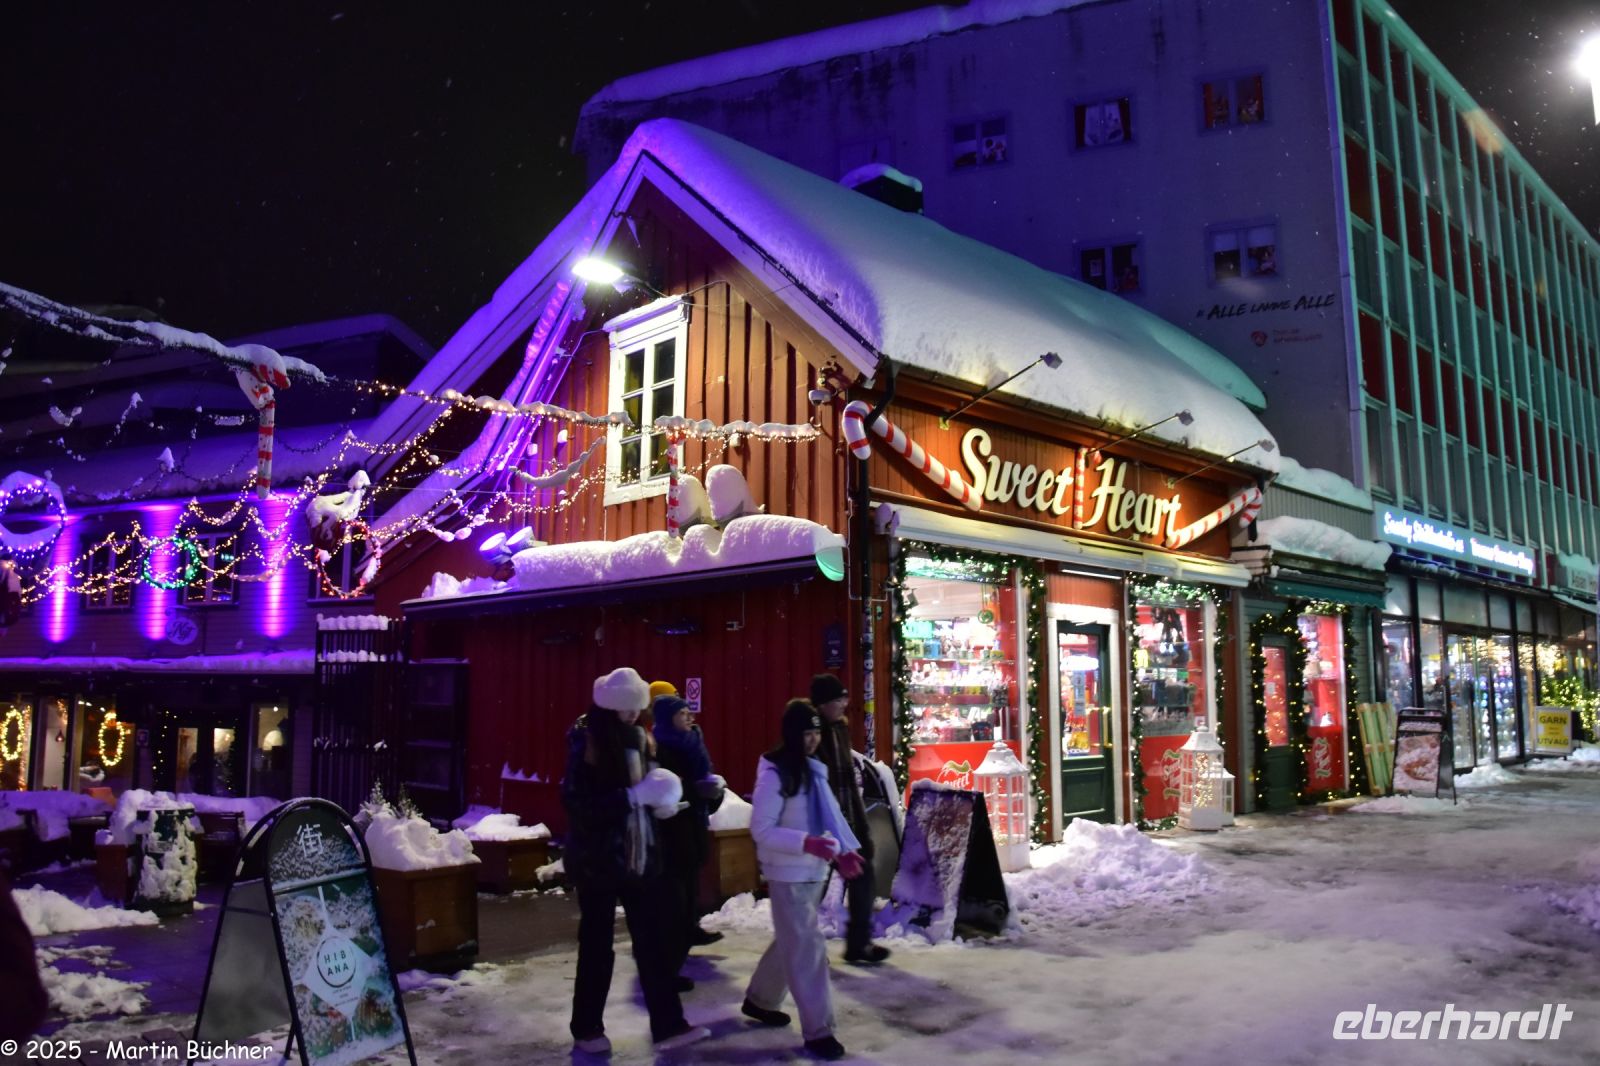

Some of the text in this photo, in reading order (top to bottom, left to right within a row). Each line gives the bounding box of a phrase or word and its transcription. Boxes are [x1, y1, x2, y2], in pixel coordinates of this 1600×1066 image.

[1207, 303, 1248, 320] ALLE
[1294, 294, 1335, 311] ALLE
[961, 428, 1182, 538] Sweet Heart
[1539, 715, 1567, 725] GARN
[324, 950, 346, 964] HIB
[327, 963, 349, 976] ANA
